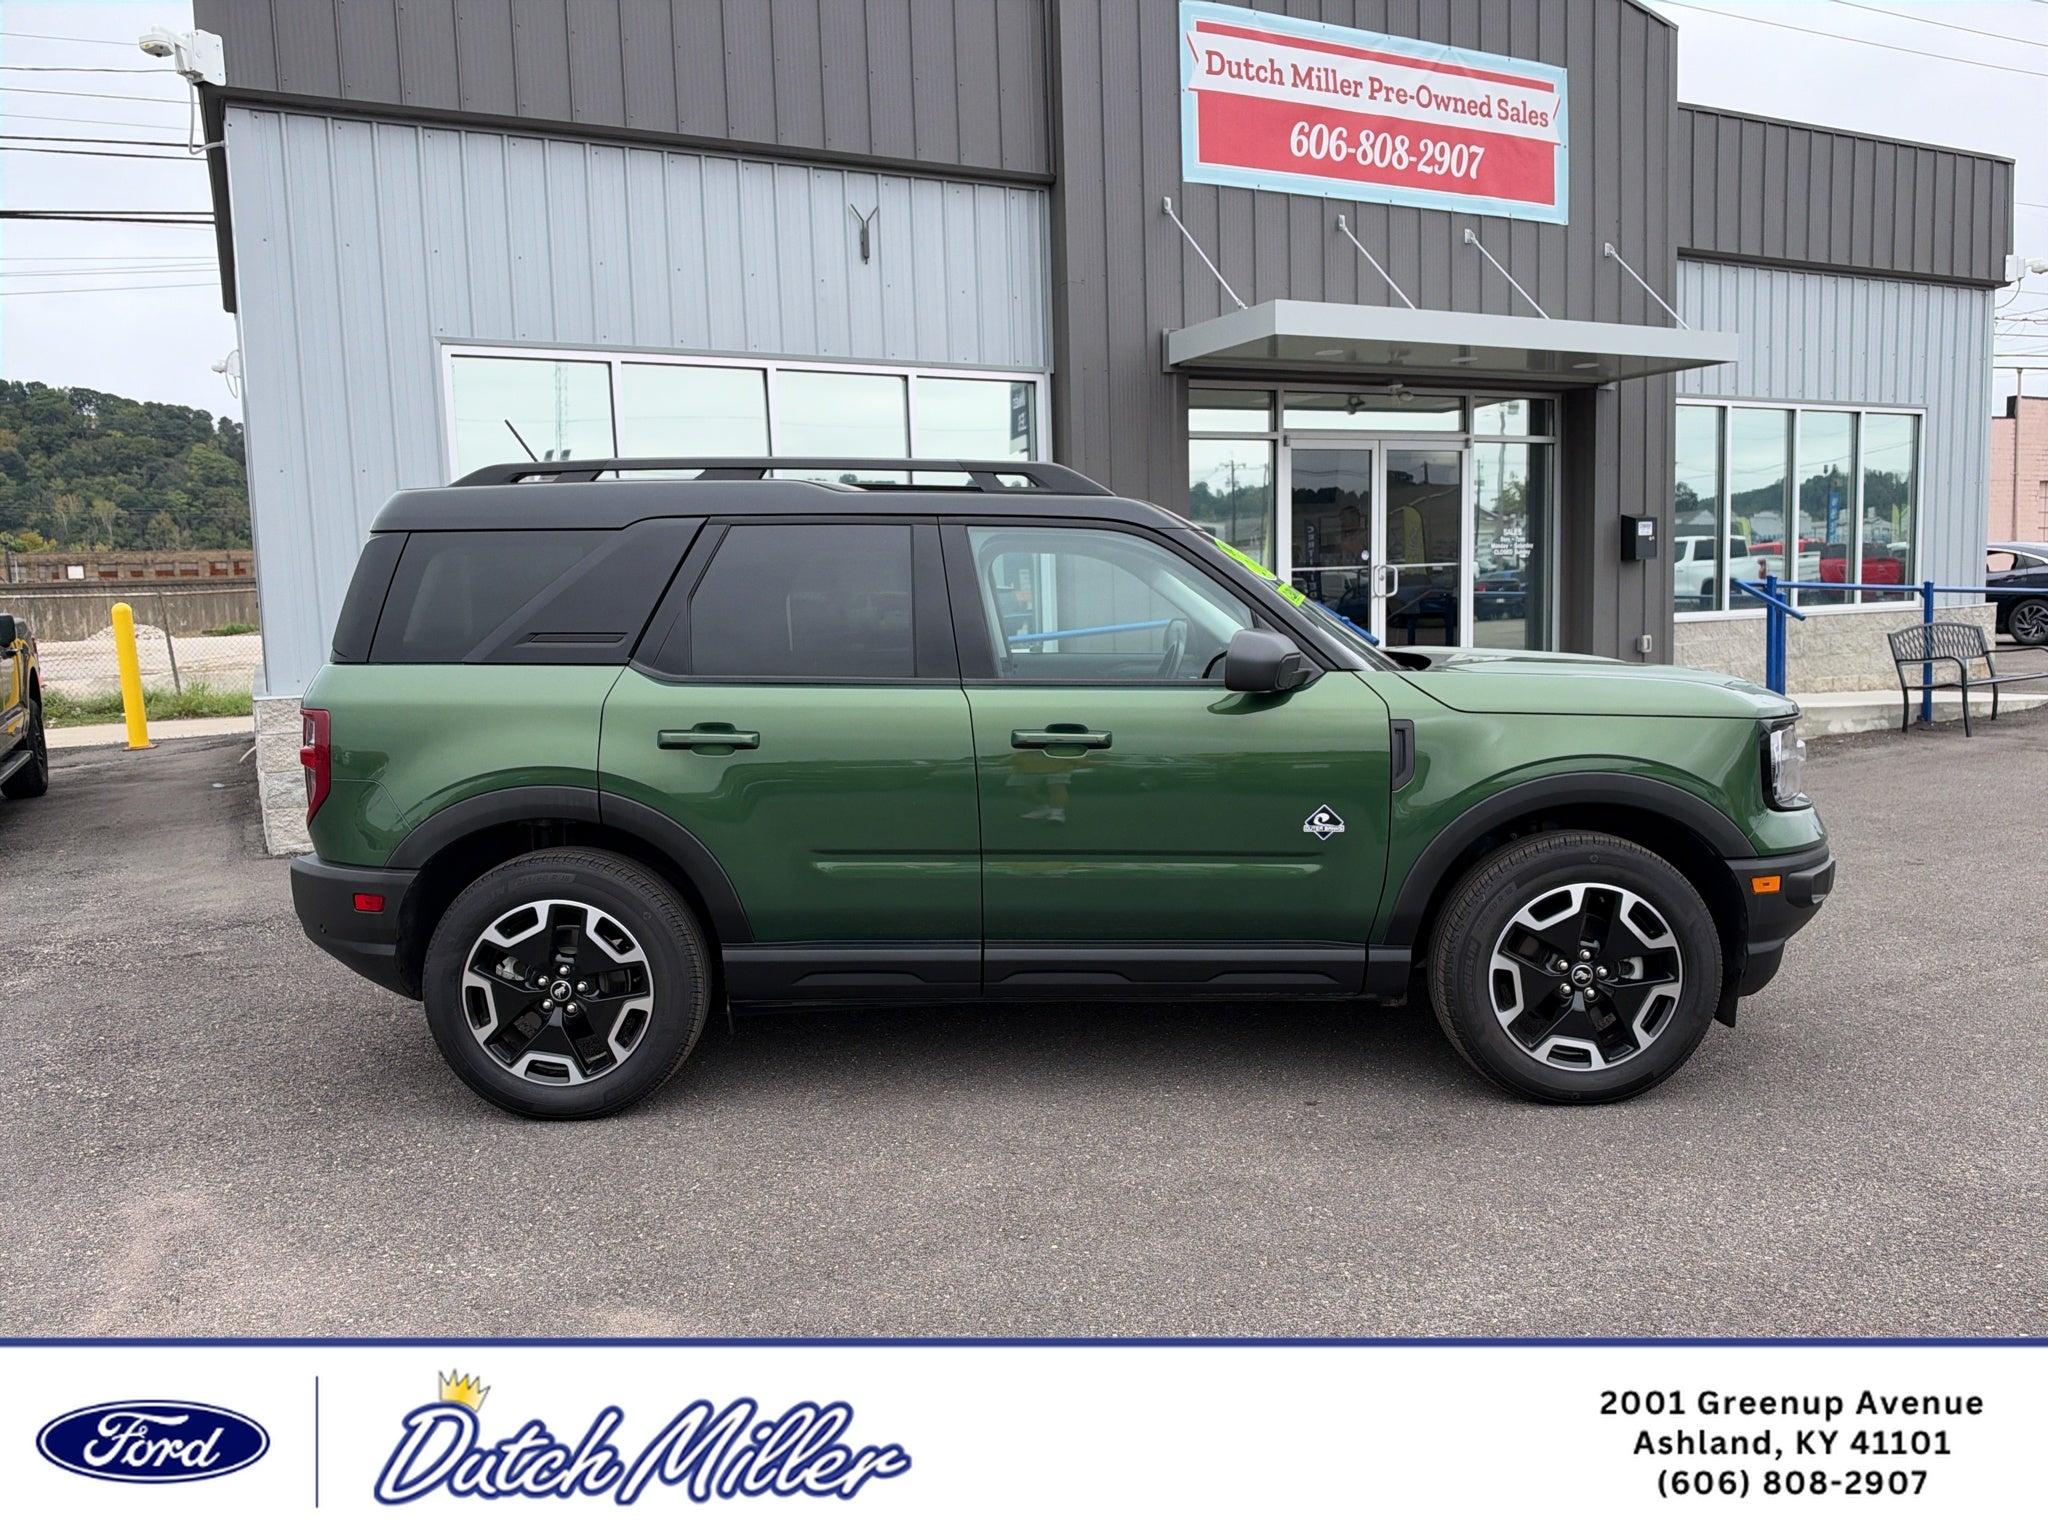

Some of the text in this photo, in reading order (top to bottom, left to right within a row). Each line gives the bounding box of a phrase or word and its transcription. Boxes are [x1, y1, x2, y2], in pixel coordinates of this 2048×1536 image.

[1205, 49, 1549, 128] Dutch Miller Pre-Owned Sales
[1290, 121, 1485, 180] 606-808-2907
[1503, 528, 1523, 536] SALES
